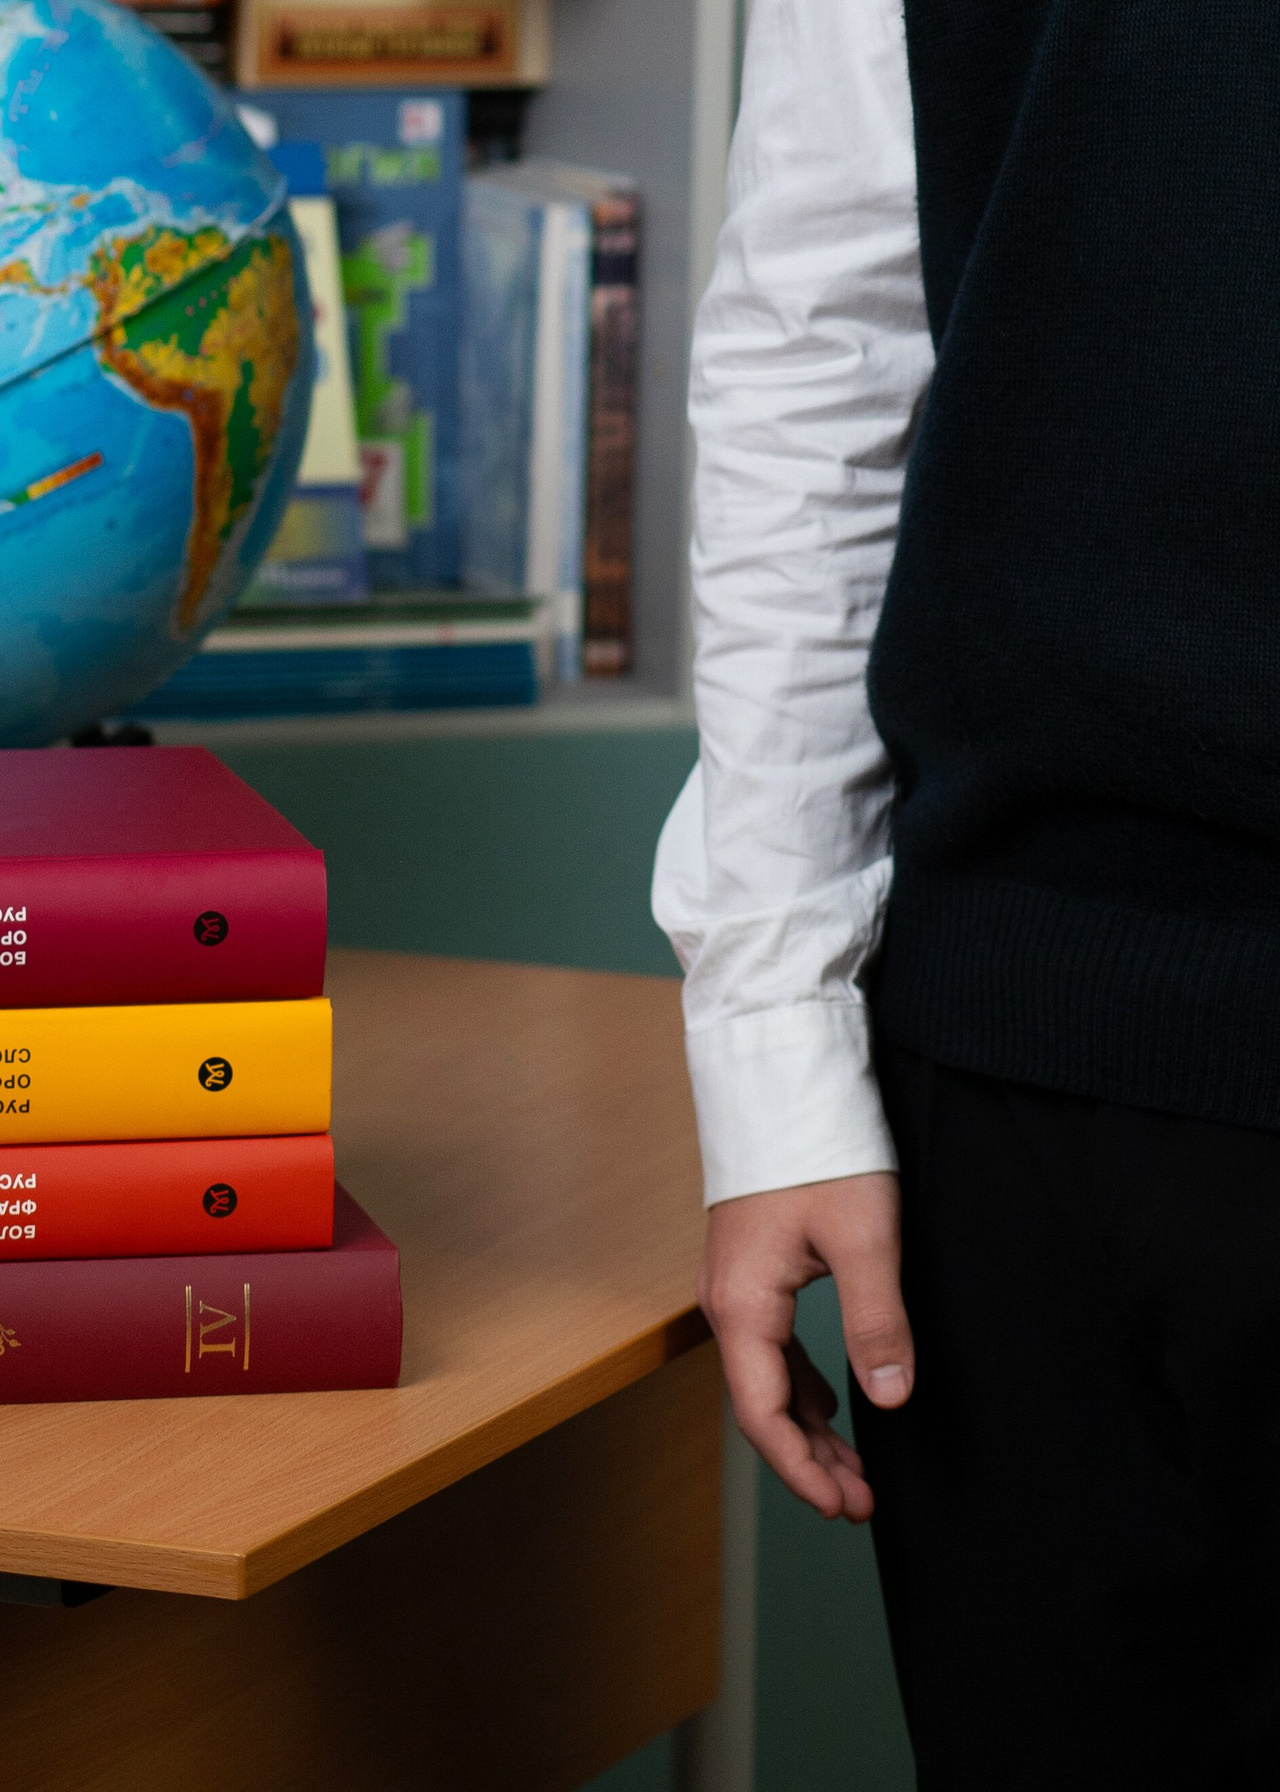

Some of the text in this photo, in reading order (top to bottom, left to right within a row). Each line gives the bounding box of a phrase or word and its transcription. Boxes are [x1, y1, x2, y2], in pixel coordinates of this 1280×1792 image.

[0, 906, 27, 922] РУ
[0, 1048, 31, 1063] СЛ
[0, 1074, 31, 1089] ОР
[0, 1173, 37, 1189] РУС
[199, 1300, 237, 1359] IV
